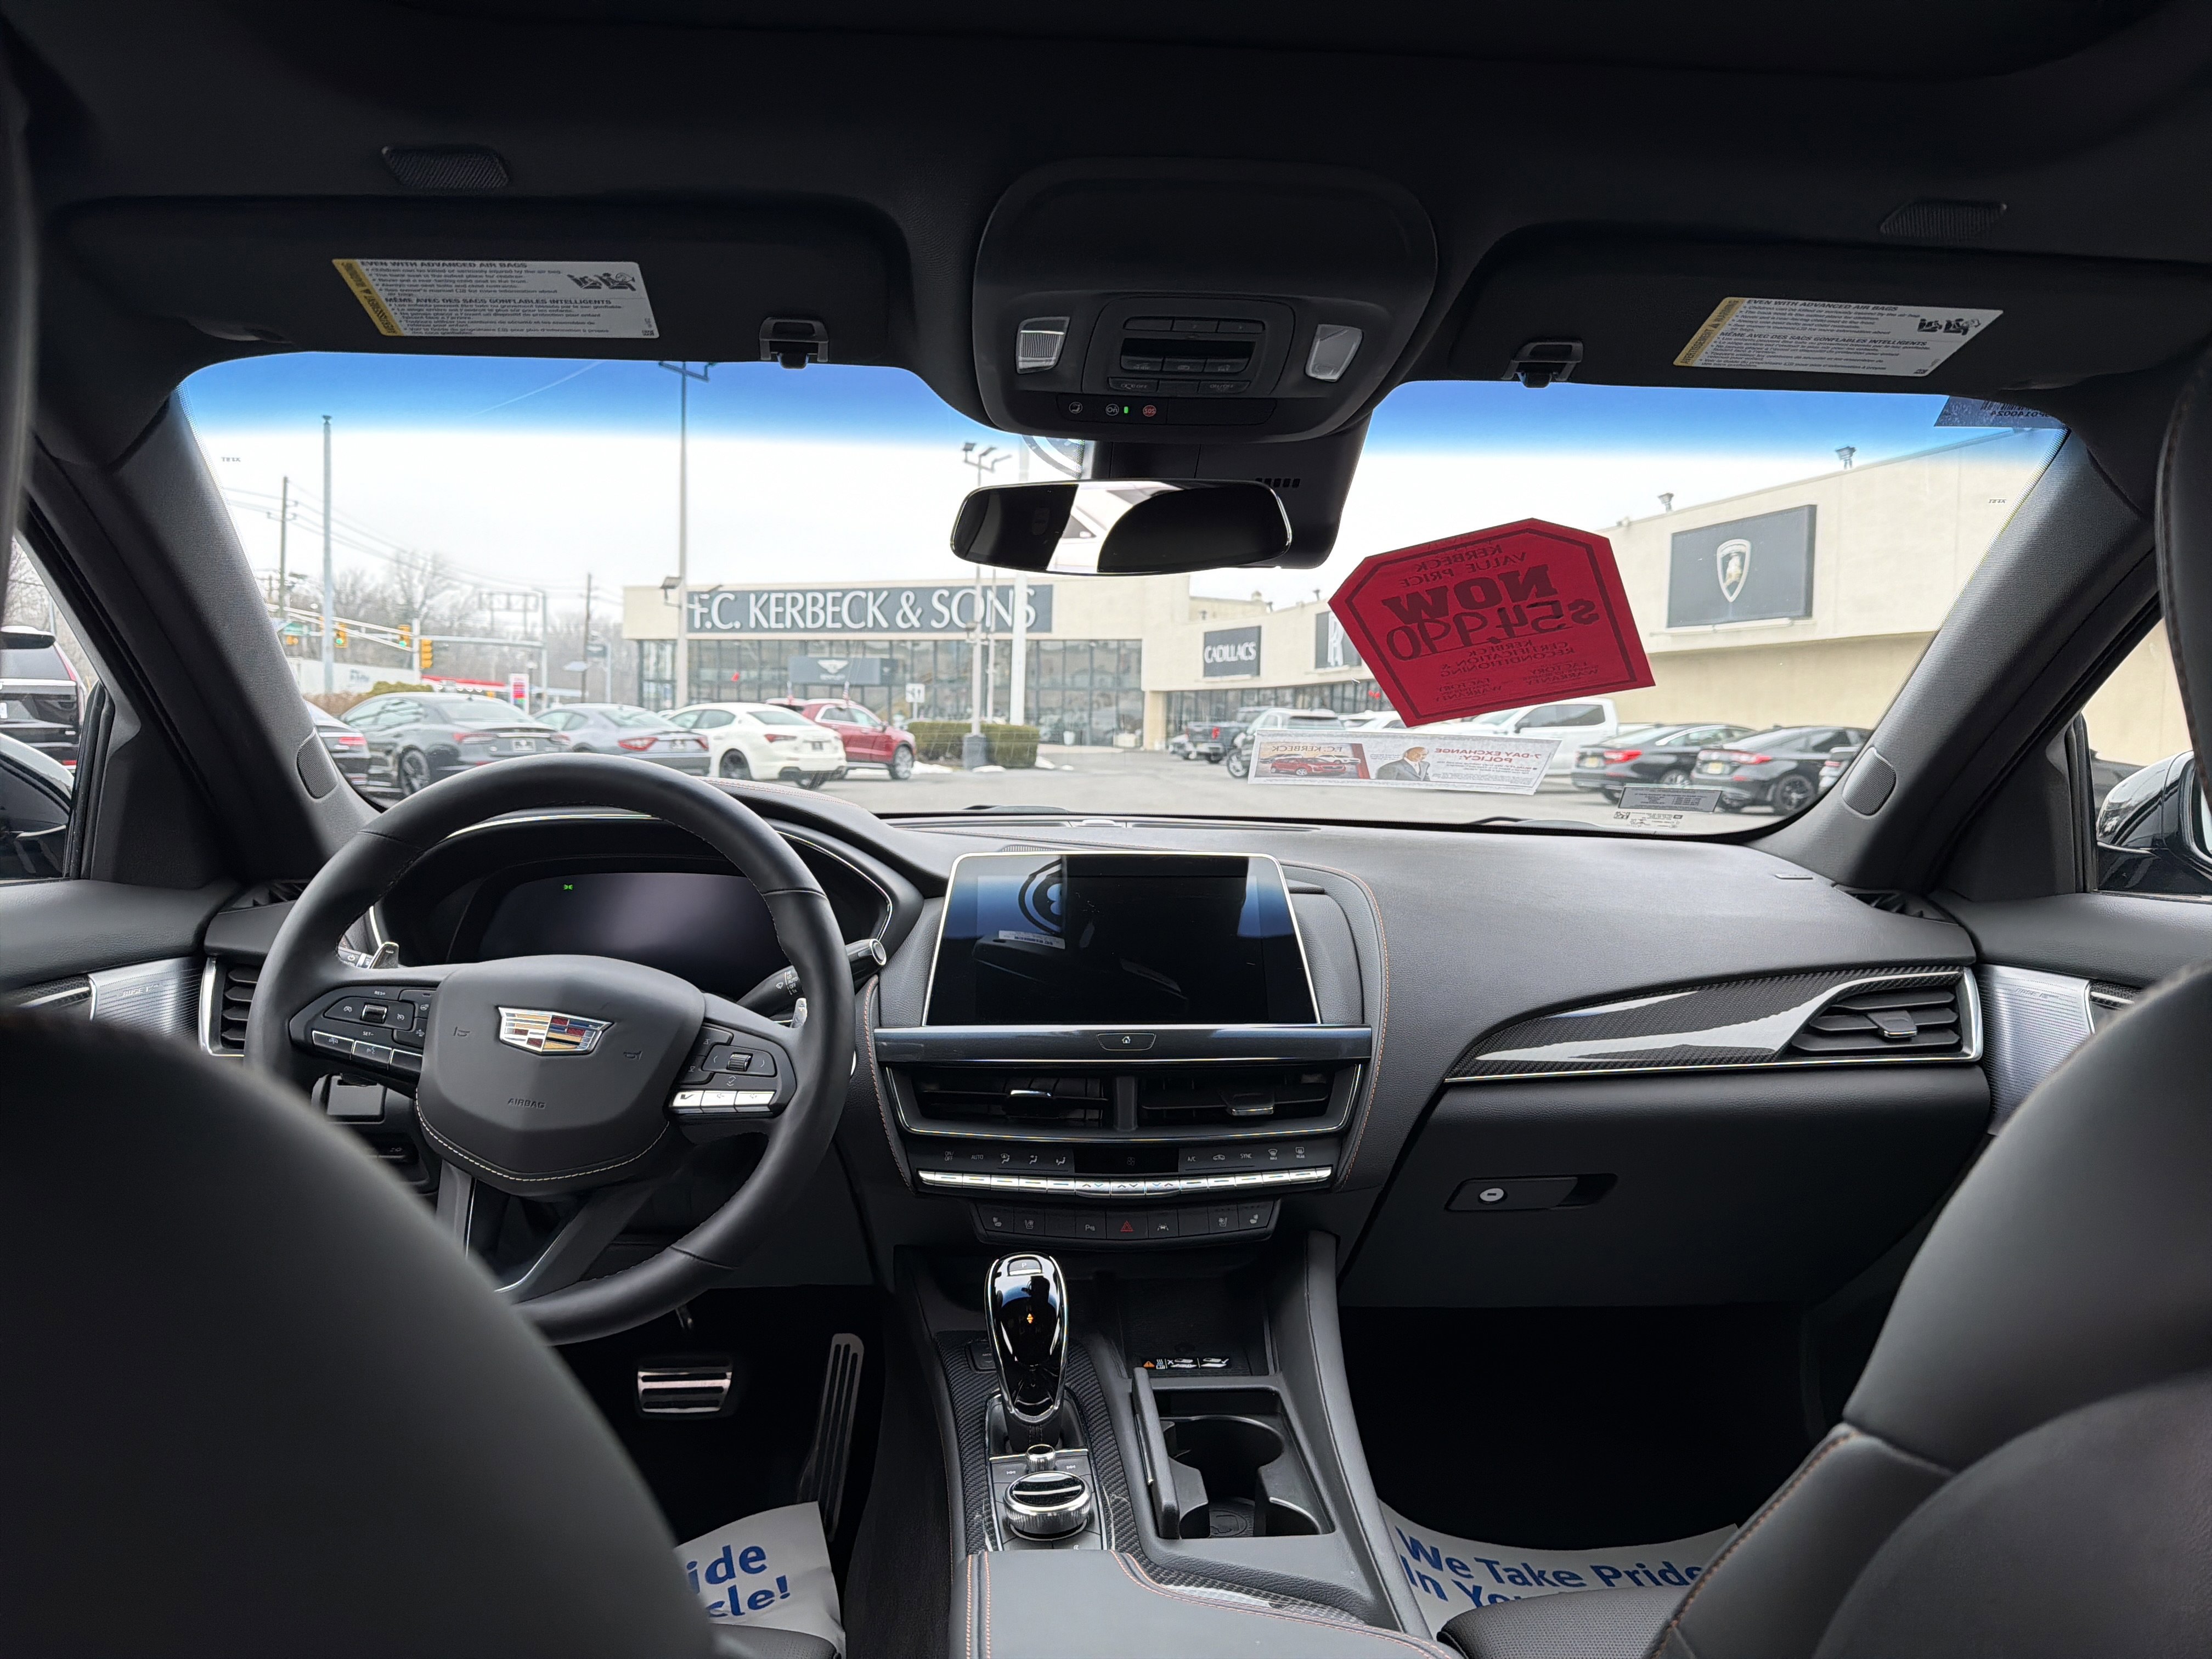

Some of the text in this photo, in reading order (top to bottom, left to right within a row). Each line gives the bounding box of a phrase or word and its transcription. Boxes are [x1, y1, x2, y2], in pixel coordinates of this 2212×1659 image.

[693, 592, 741, 629] F.C.
[749, 590, 889, 629] KERBECK
[895, 590, 922, 629] &
[507, 1097, 545, 1109] AIRBAG
[686, 1544, 768, 1595] ide
[1395, 1525, 1475, 1579] We
[1474, 1558, 1587, 1588] Take
[1401, 1555, 1449, 1602] In
